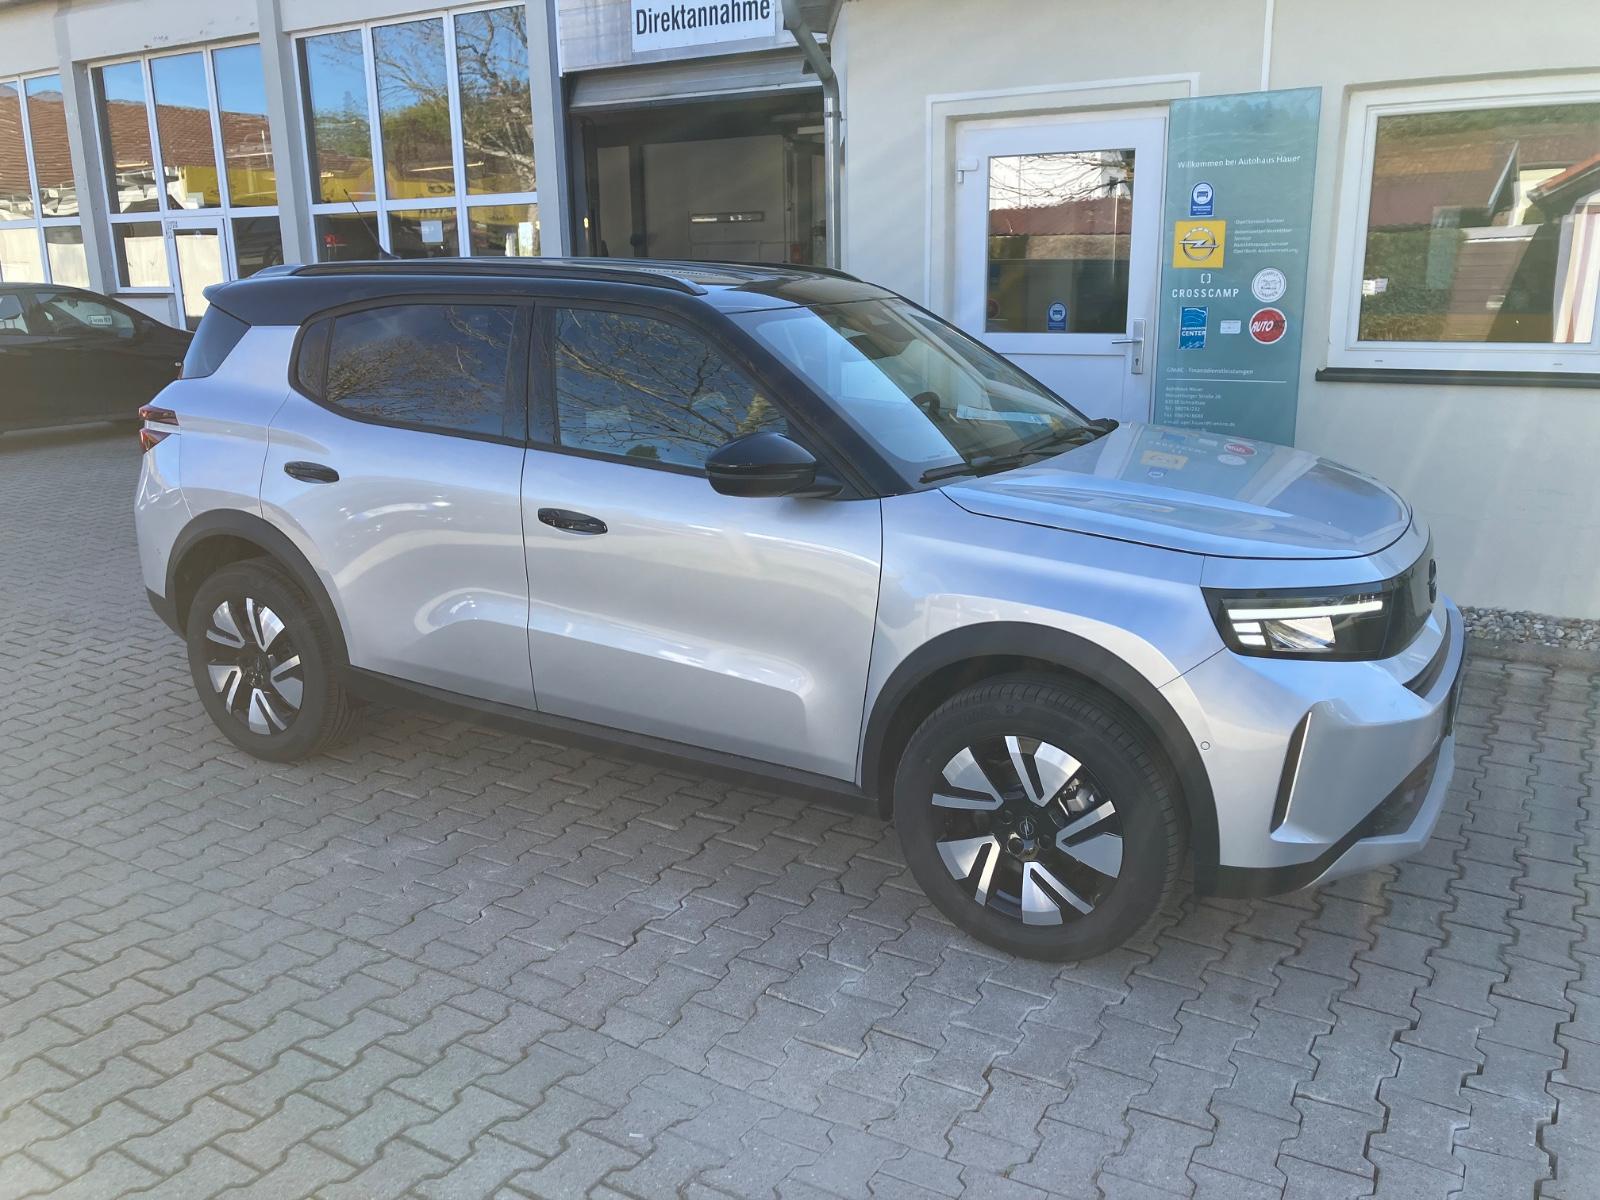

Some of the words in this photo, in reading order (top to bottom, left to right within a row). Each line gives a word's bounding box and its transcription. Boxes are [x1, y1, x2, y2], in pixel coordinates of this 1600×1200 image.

[636, 0, 770, 35] Direktannahme
[1177, 160, 1224, 168] Willkommen
[1225, 158, 1237, 166] bei
[1239, 156, 1274, 165] Autohaus
[1171, 288, 1240, 298] CROSSCAMP
